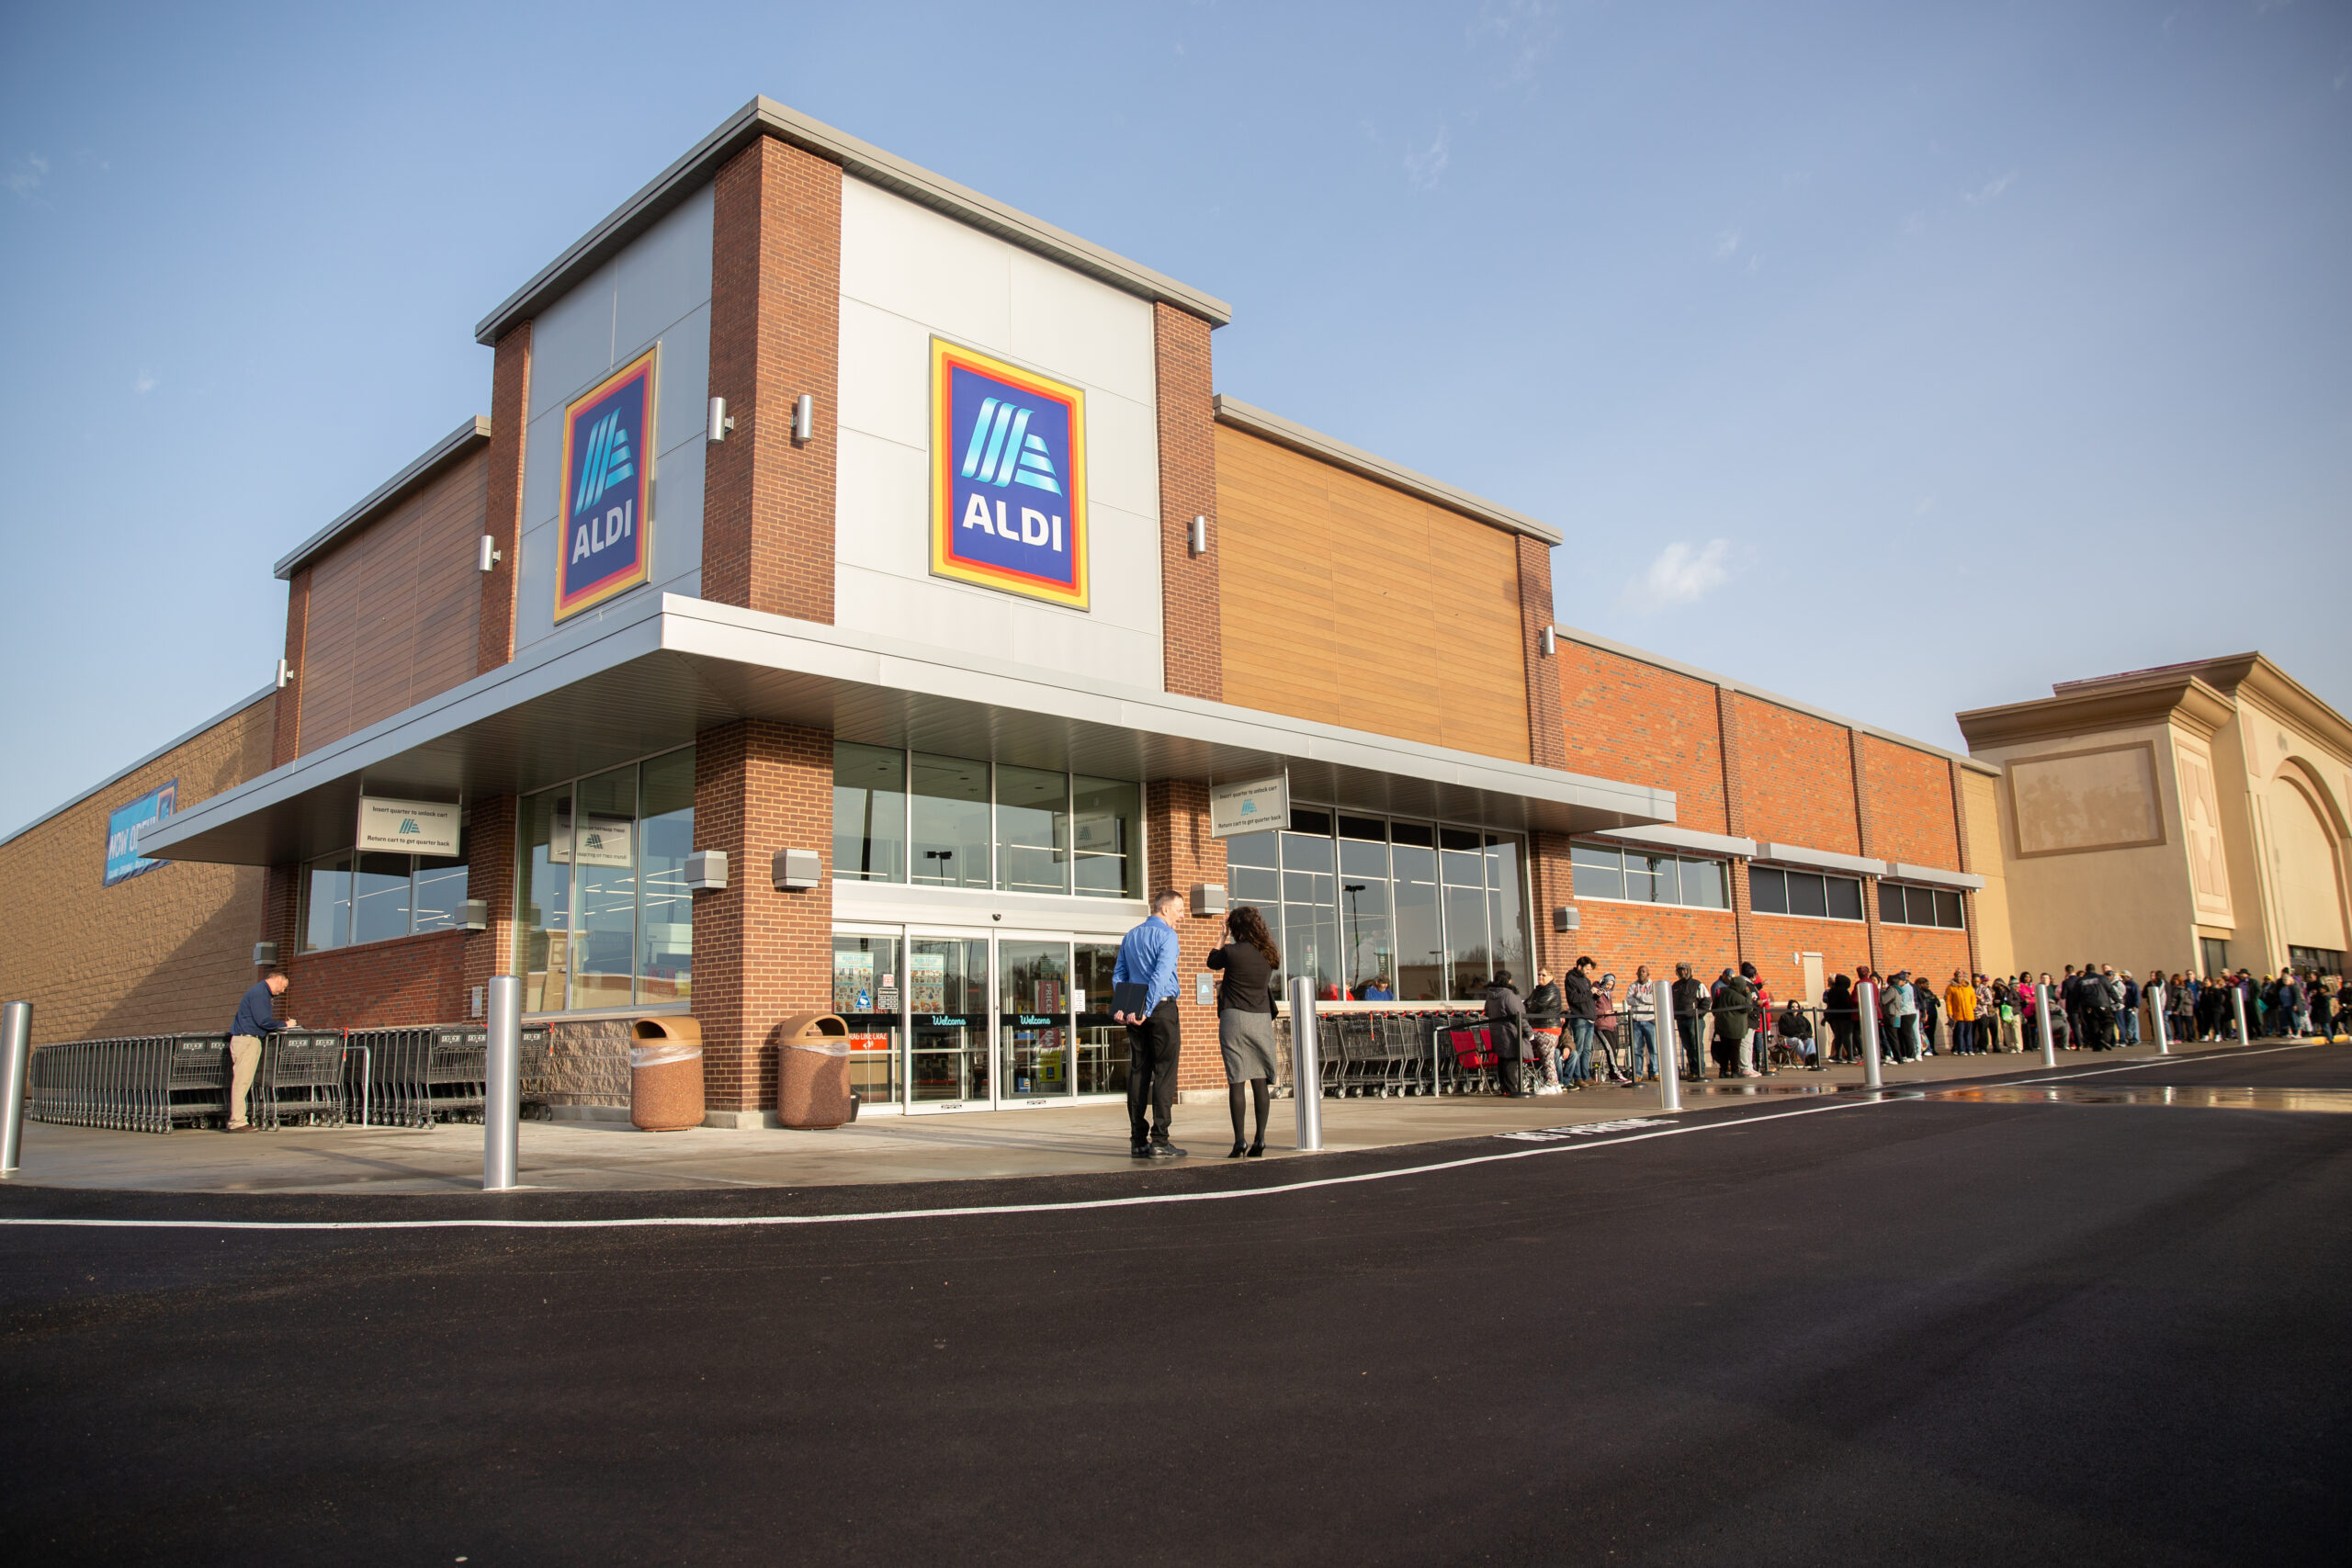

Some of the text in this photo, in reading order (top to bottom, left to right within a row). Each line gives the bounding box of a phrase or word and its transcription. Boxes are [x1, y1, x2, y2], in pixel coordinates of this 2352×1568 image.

[571, 498, 632, 565] ALDI
[962, 493, 1063, 553] ALDI
[108, 828, 130, 861] NOW
[932, 1015, 967, 1026] Welcome
[1020, 1014, 1051, 1025] Welcome
